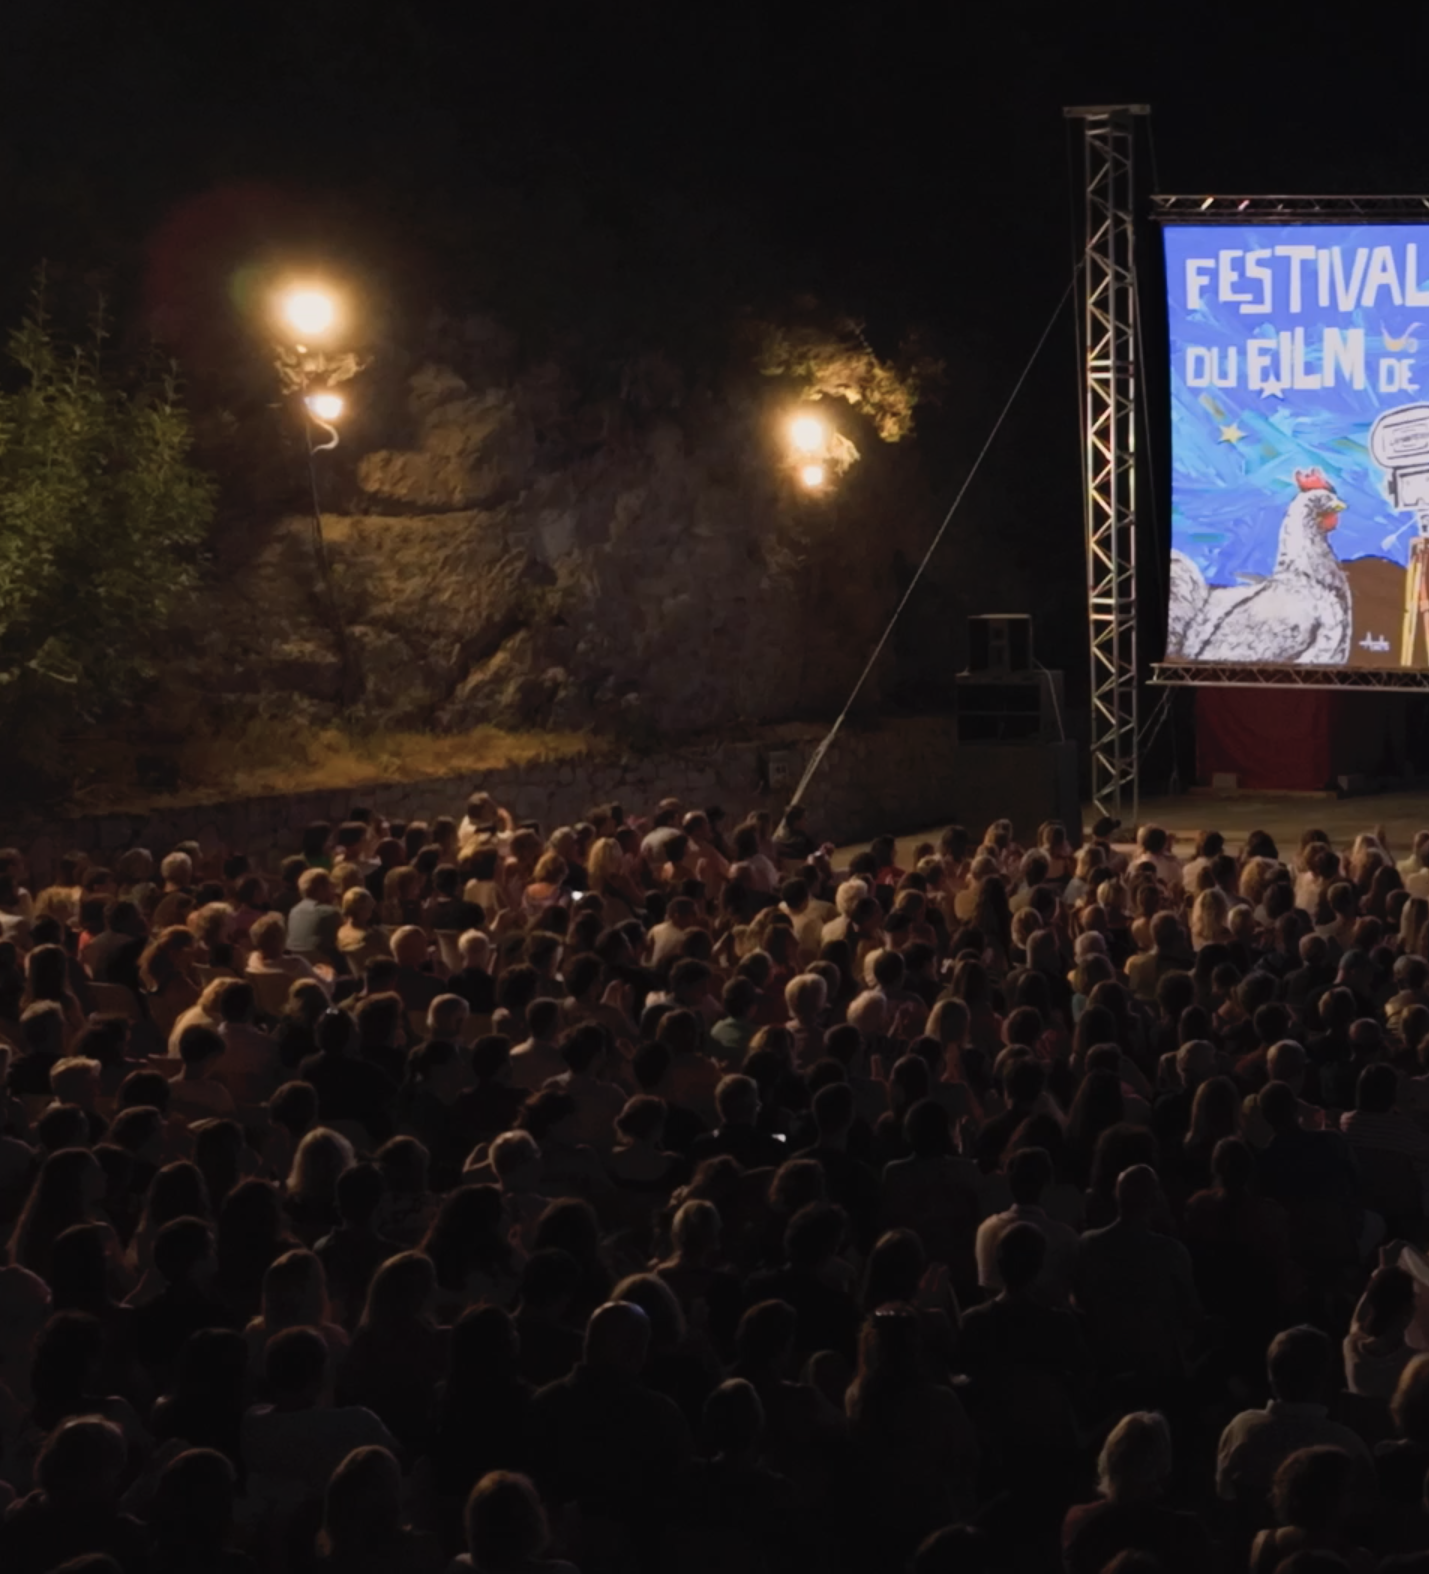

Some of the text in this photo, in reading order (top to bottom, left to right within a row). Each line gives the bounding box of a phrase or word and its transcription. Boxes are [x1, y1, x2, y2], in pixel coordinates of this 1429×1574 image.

[1186, 345, 1238, 389] DU
[1247, 327, 1366, 391] FILM
[1379, 357, 1420, 393] DE
